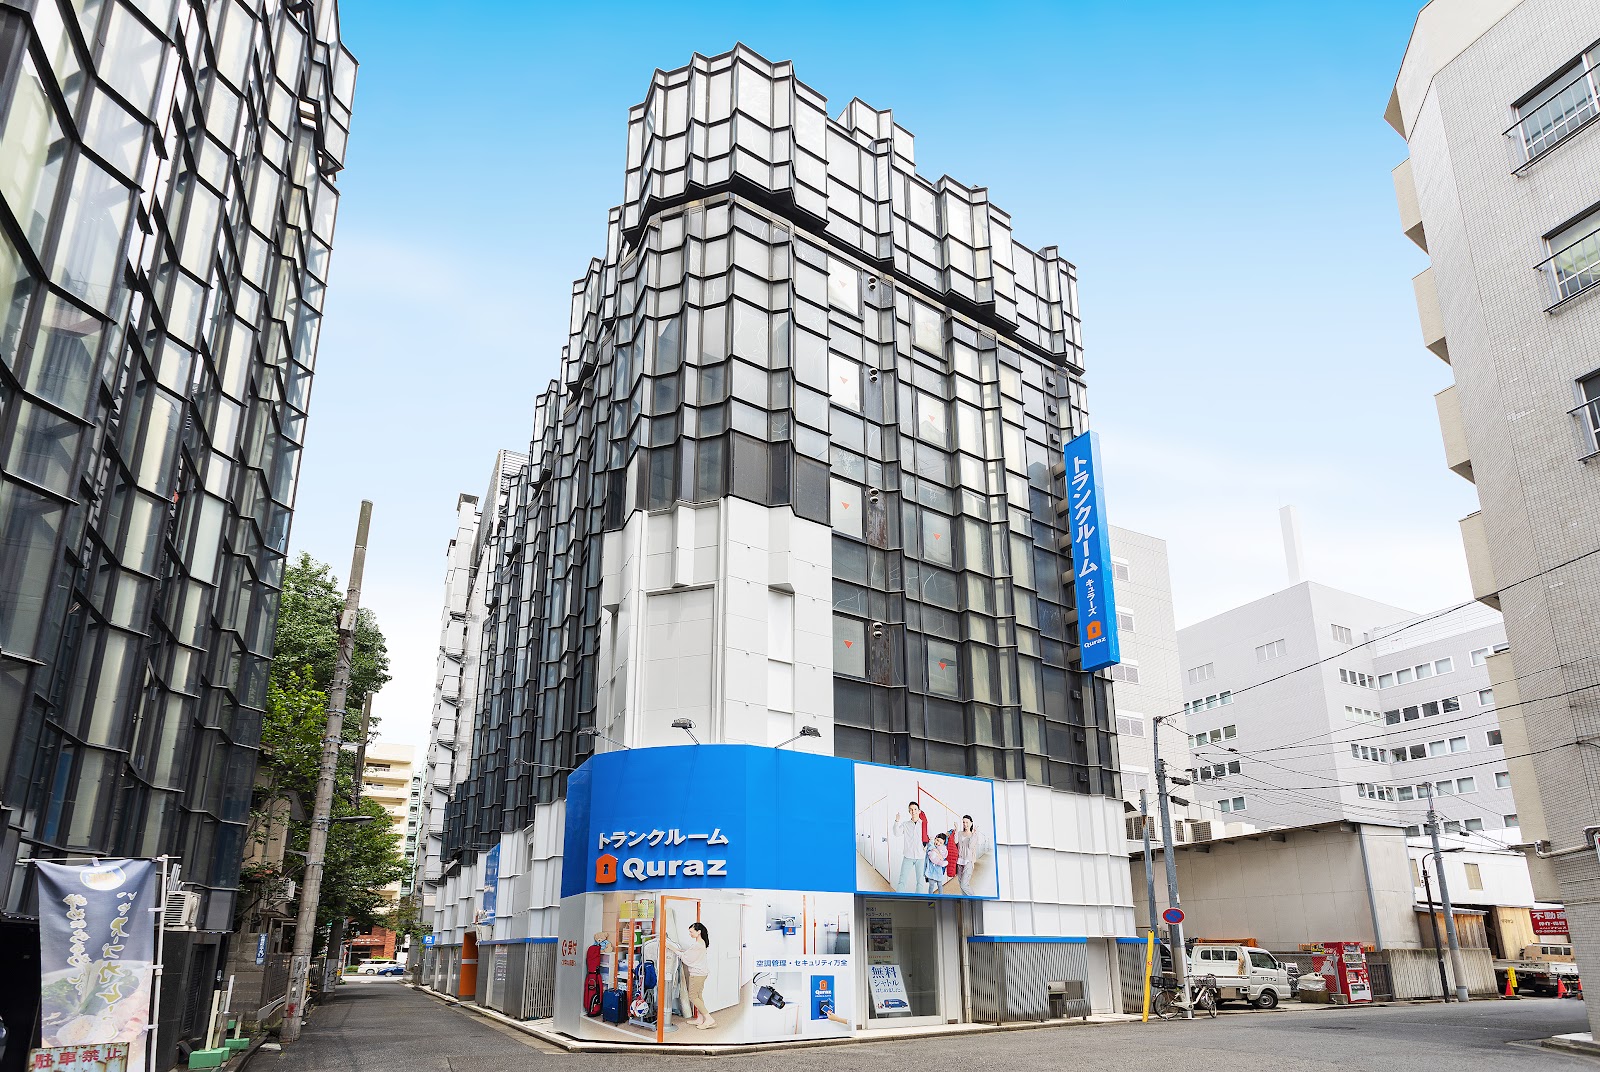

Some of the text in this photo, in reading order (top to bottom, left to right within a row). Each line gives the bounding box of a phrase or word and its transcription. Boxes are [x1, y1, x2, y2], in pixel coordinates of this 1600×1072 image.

[1071, 455, 1099, 578] トランクルーム
[1085, 578, 1098, 616] キュラーズ
[1083, 636, 1107, 649] Quraz
[598, 828, 729, 848] トランクルーム
[621, 857, 728, 882] Quraz
[755, 959, 848, 967] 空調管理・セキュリティ万全
[871, 966, 897, 979] 無料
[874, 979, 900, 987] シャトル
[34, 1048, 121, 1069] 駐車禁止
